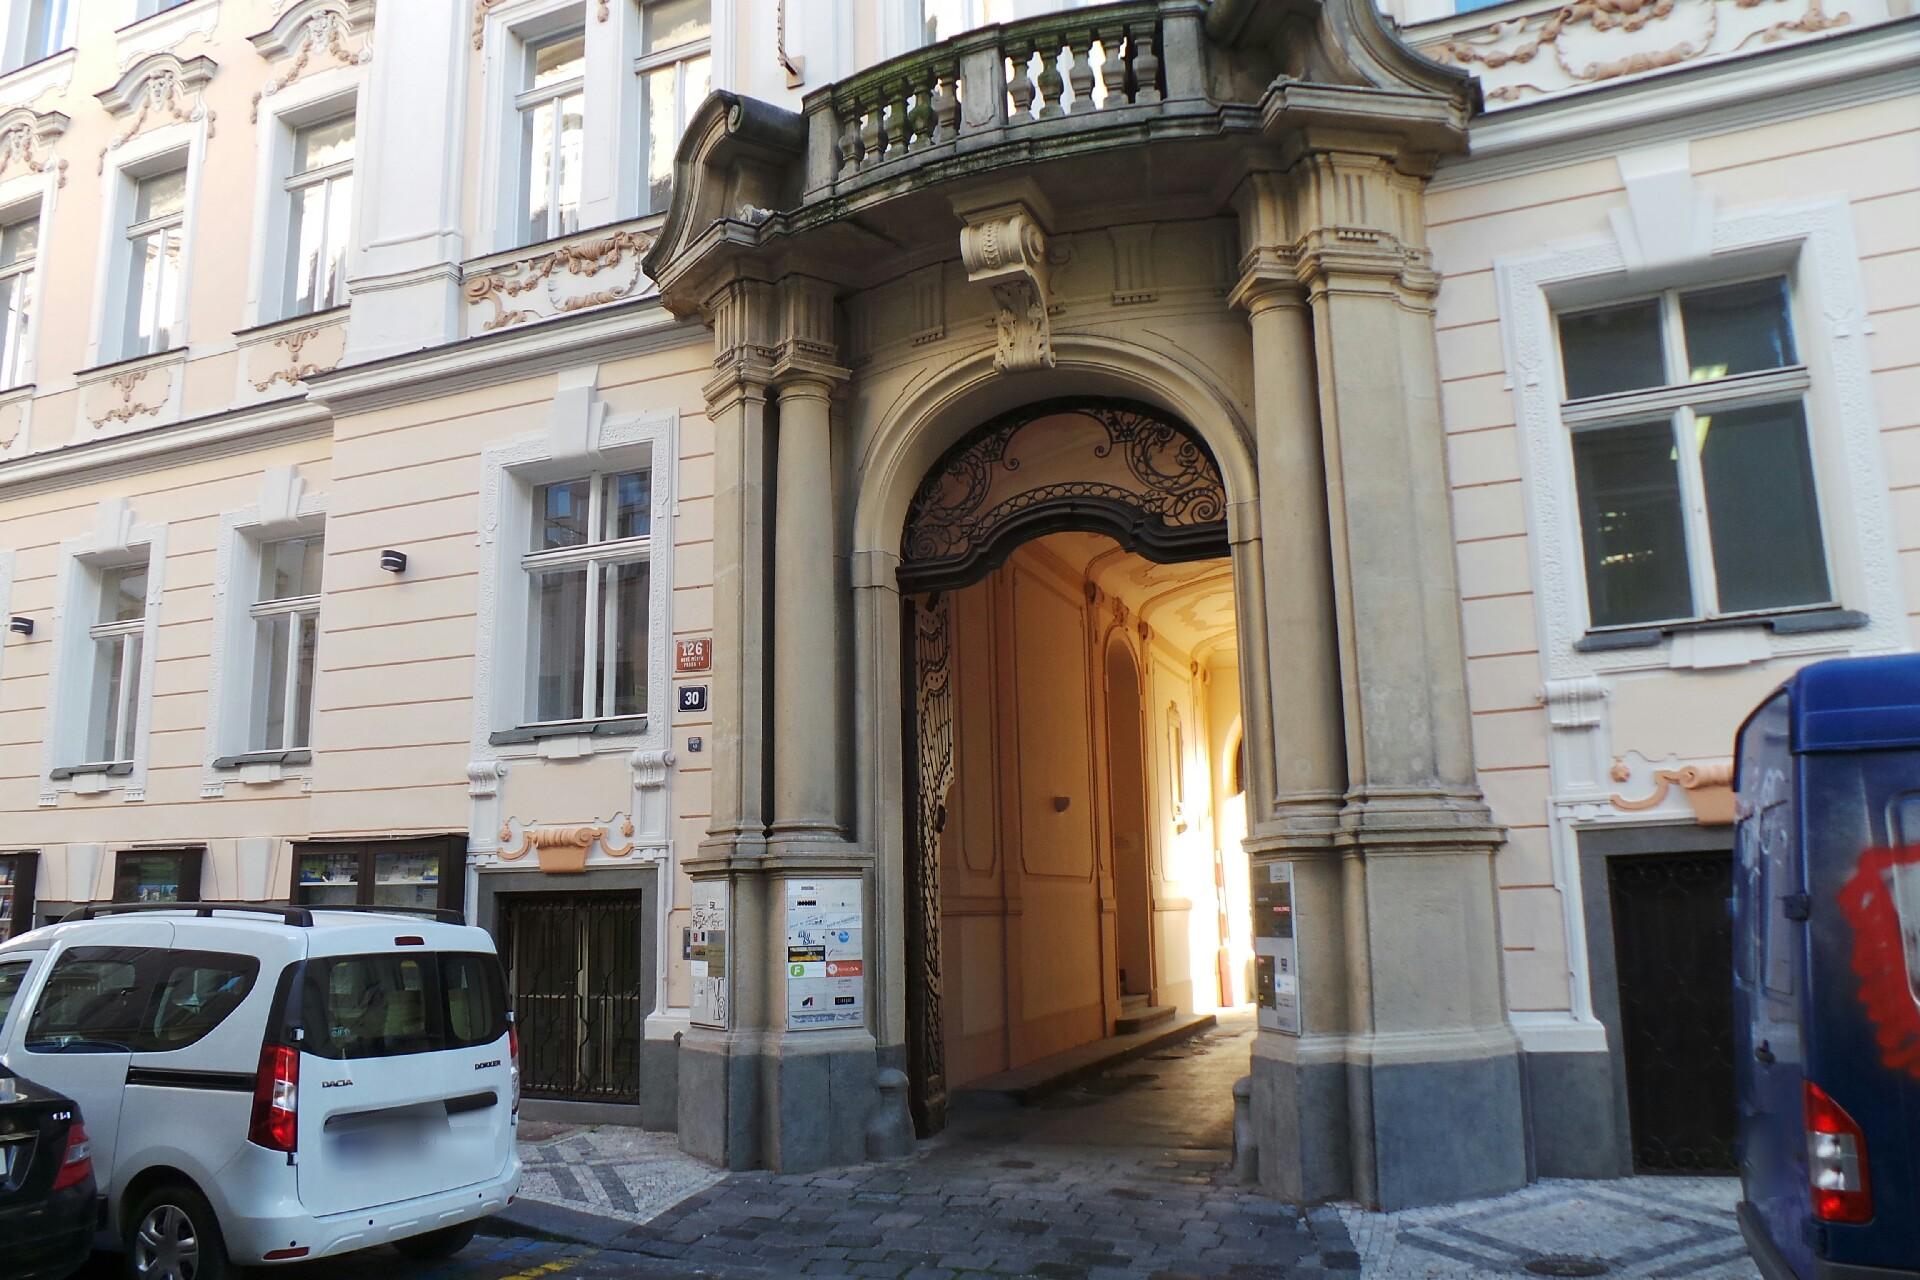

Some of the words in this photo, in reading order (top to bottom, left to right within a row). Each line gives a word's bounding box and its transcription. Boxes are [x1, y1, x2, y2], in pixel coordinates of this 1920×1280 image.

[682, 642, 703, 656] 126
[684, 691, 699, 705] 30
[474, 1060, 501, 1070] DOKKER
[322, 1079, 353, 1088] DACIA
